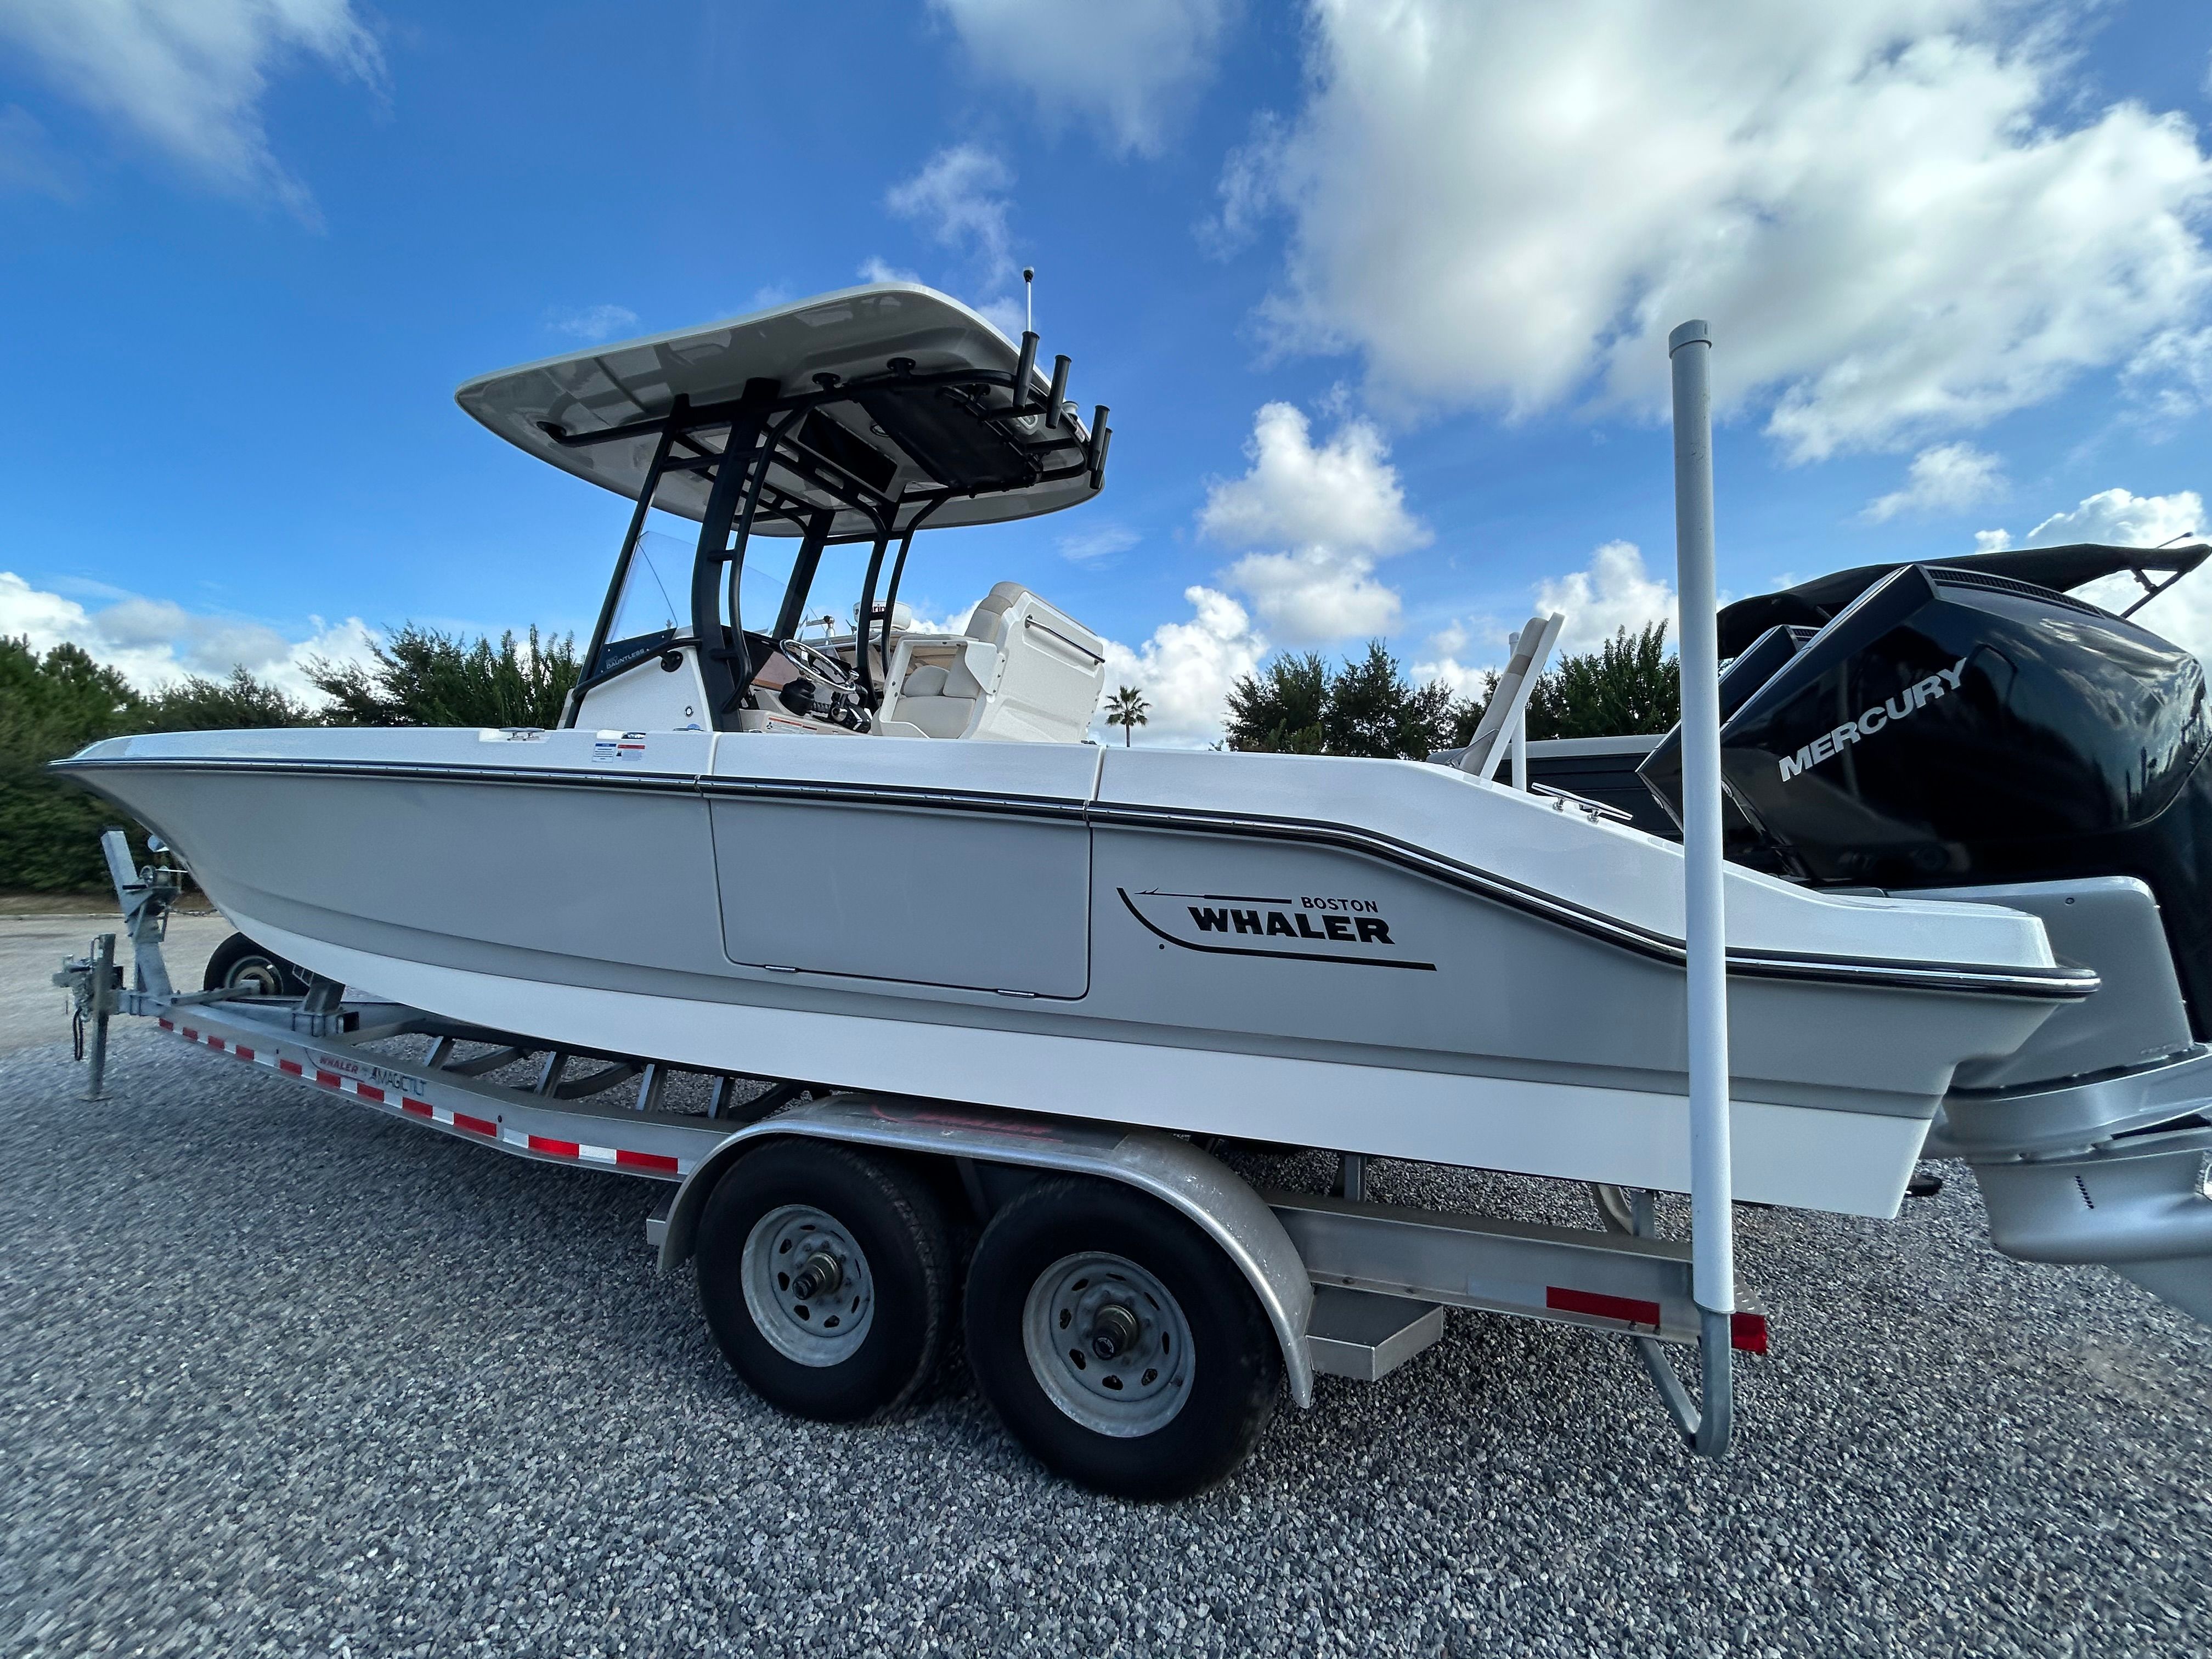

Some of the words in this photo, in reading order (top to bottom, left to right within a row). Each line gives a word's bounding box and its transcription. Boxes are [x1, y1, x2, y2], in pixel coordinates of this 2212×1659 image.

[1778, 657, 1967, 782] MERCURY
[1301, 896, 1378, 913] BOSTON
[1187, 906, 1395, 945] WHALER
[319, 1054, 359, 1074] WHALER
